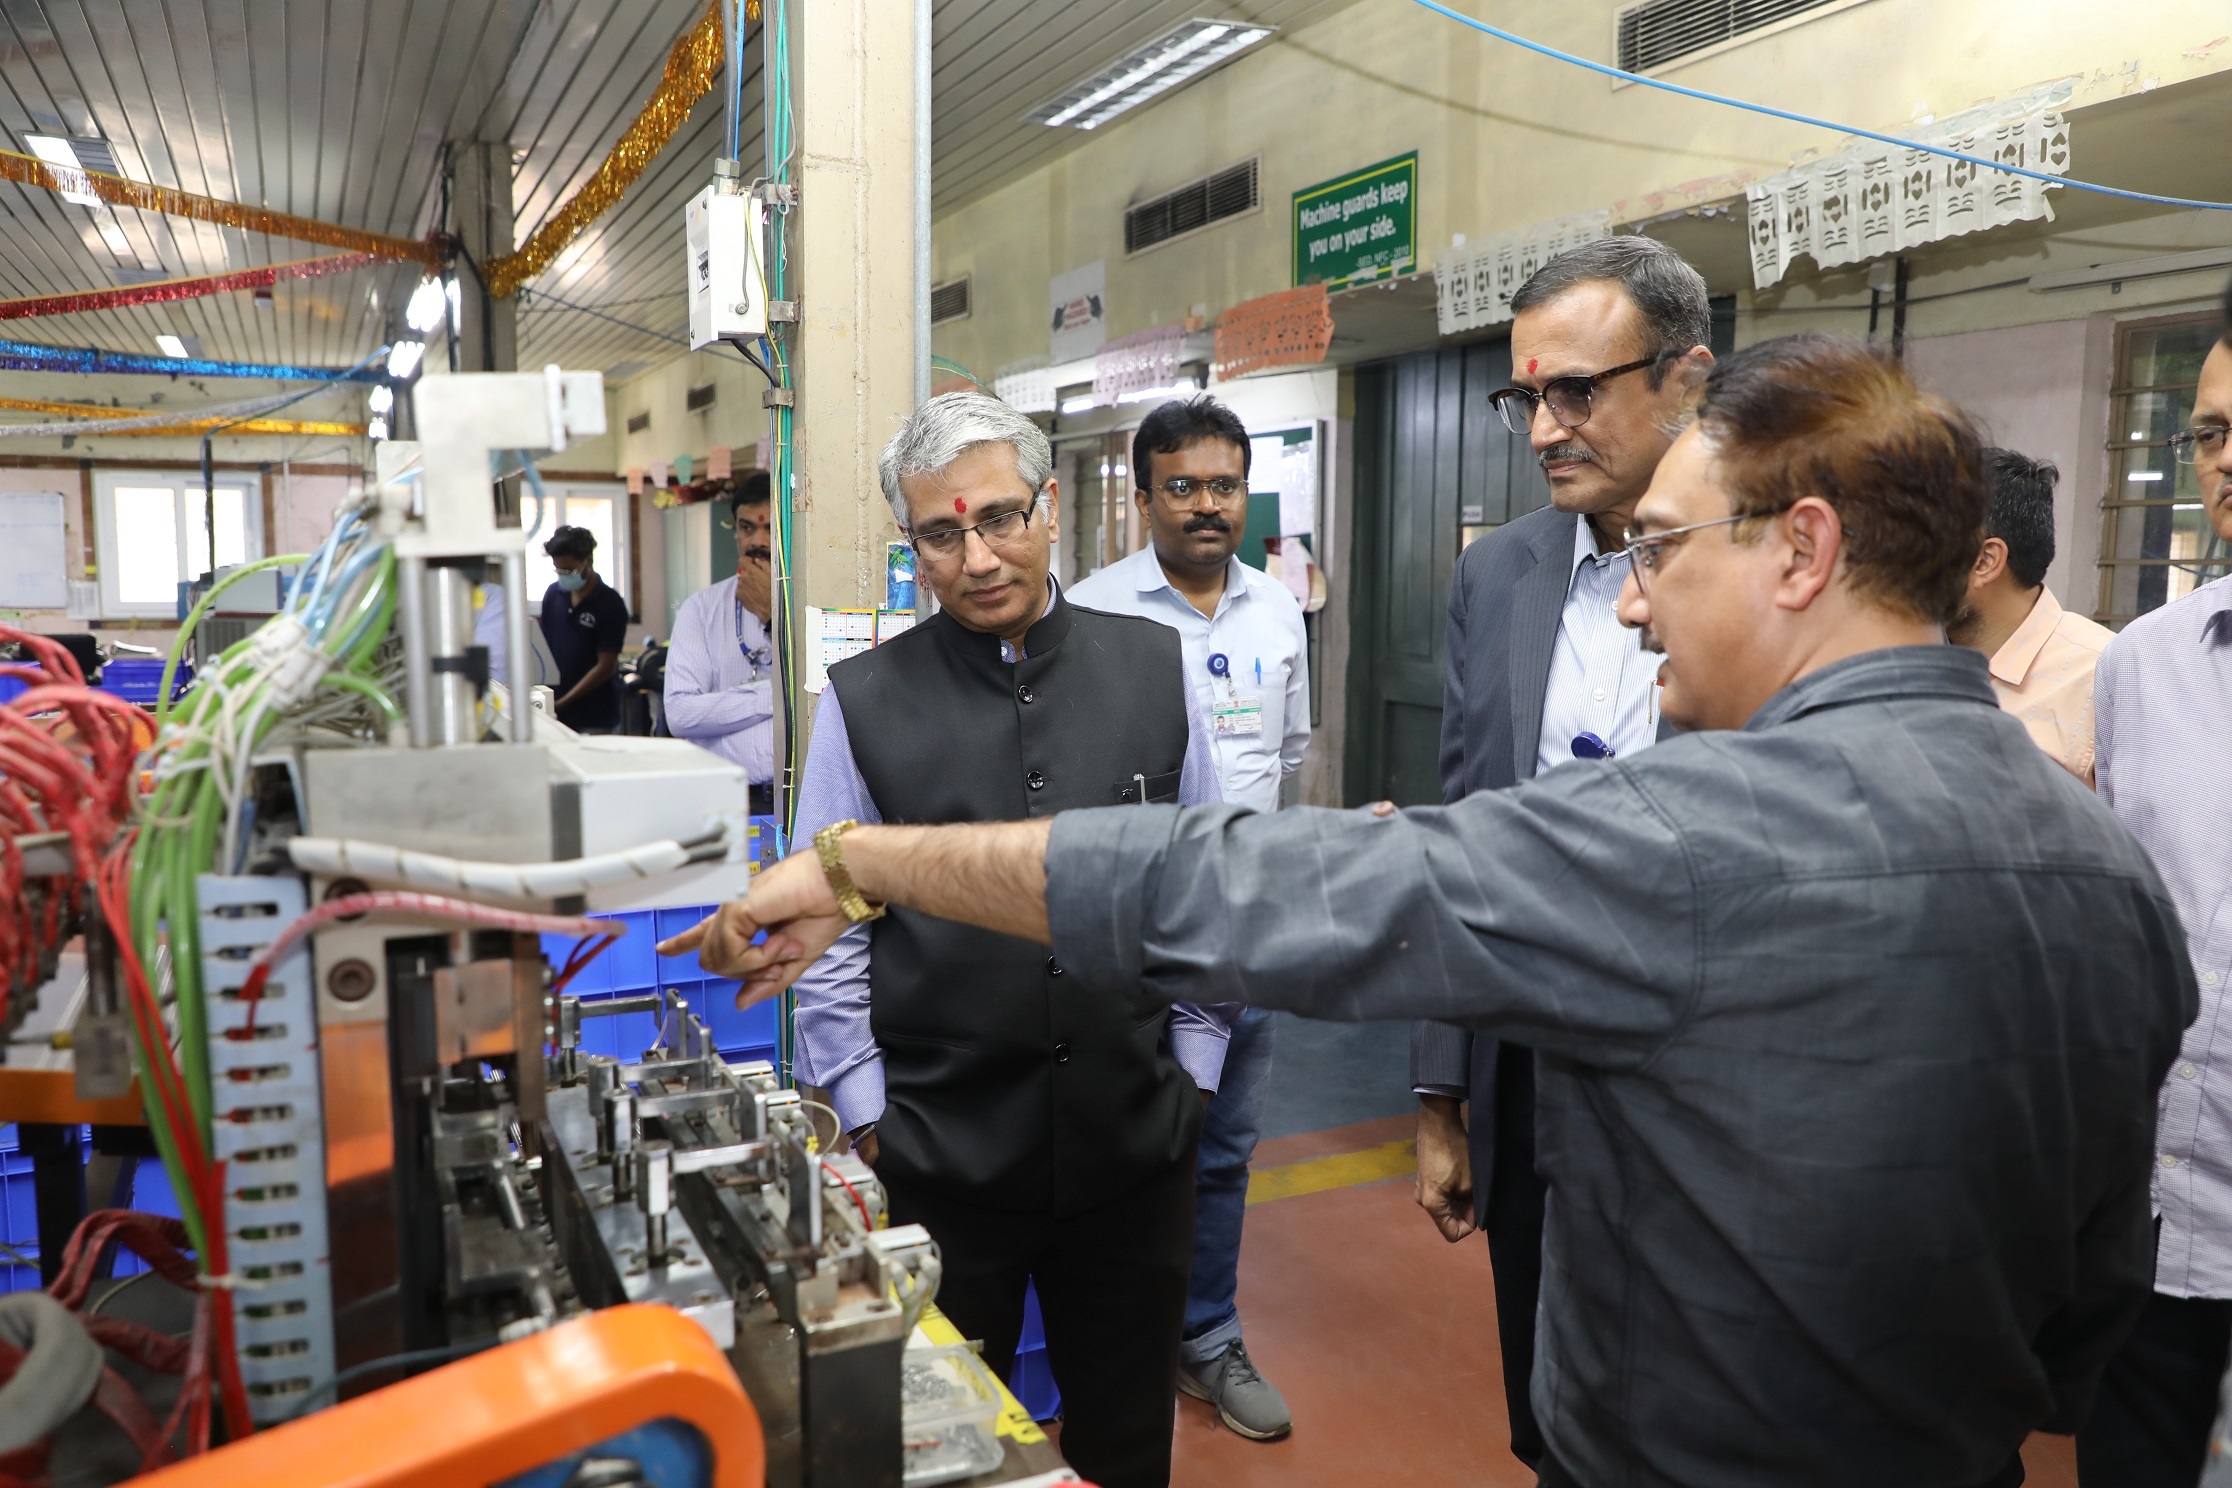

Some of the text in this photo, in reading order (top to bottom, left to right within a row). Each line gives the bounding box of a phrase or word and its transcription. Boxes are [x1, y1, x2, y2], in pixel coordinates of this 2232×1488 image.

[1300, 180, 1408, 231] Machine guards keep
[1309, 214, 1396, 263] you on your side.
